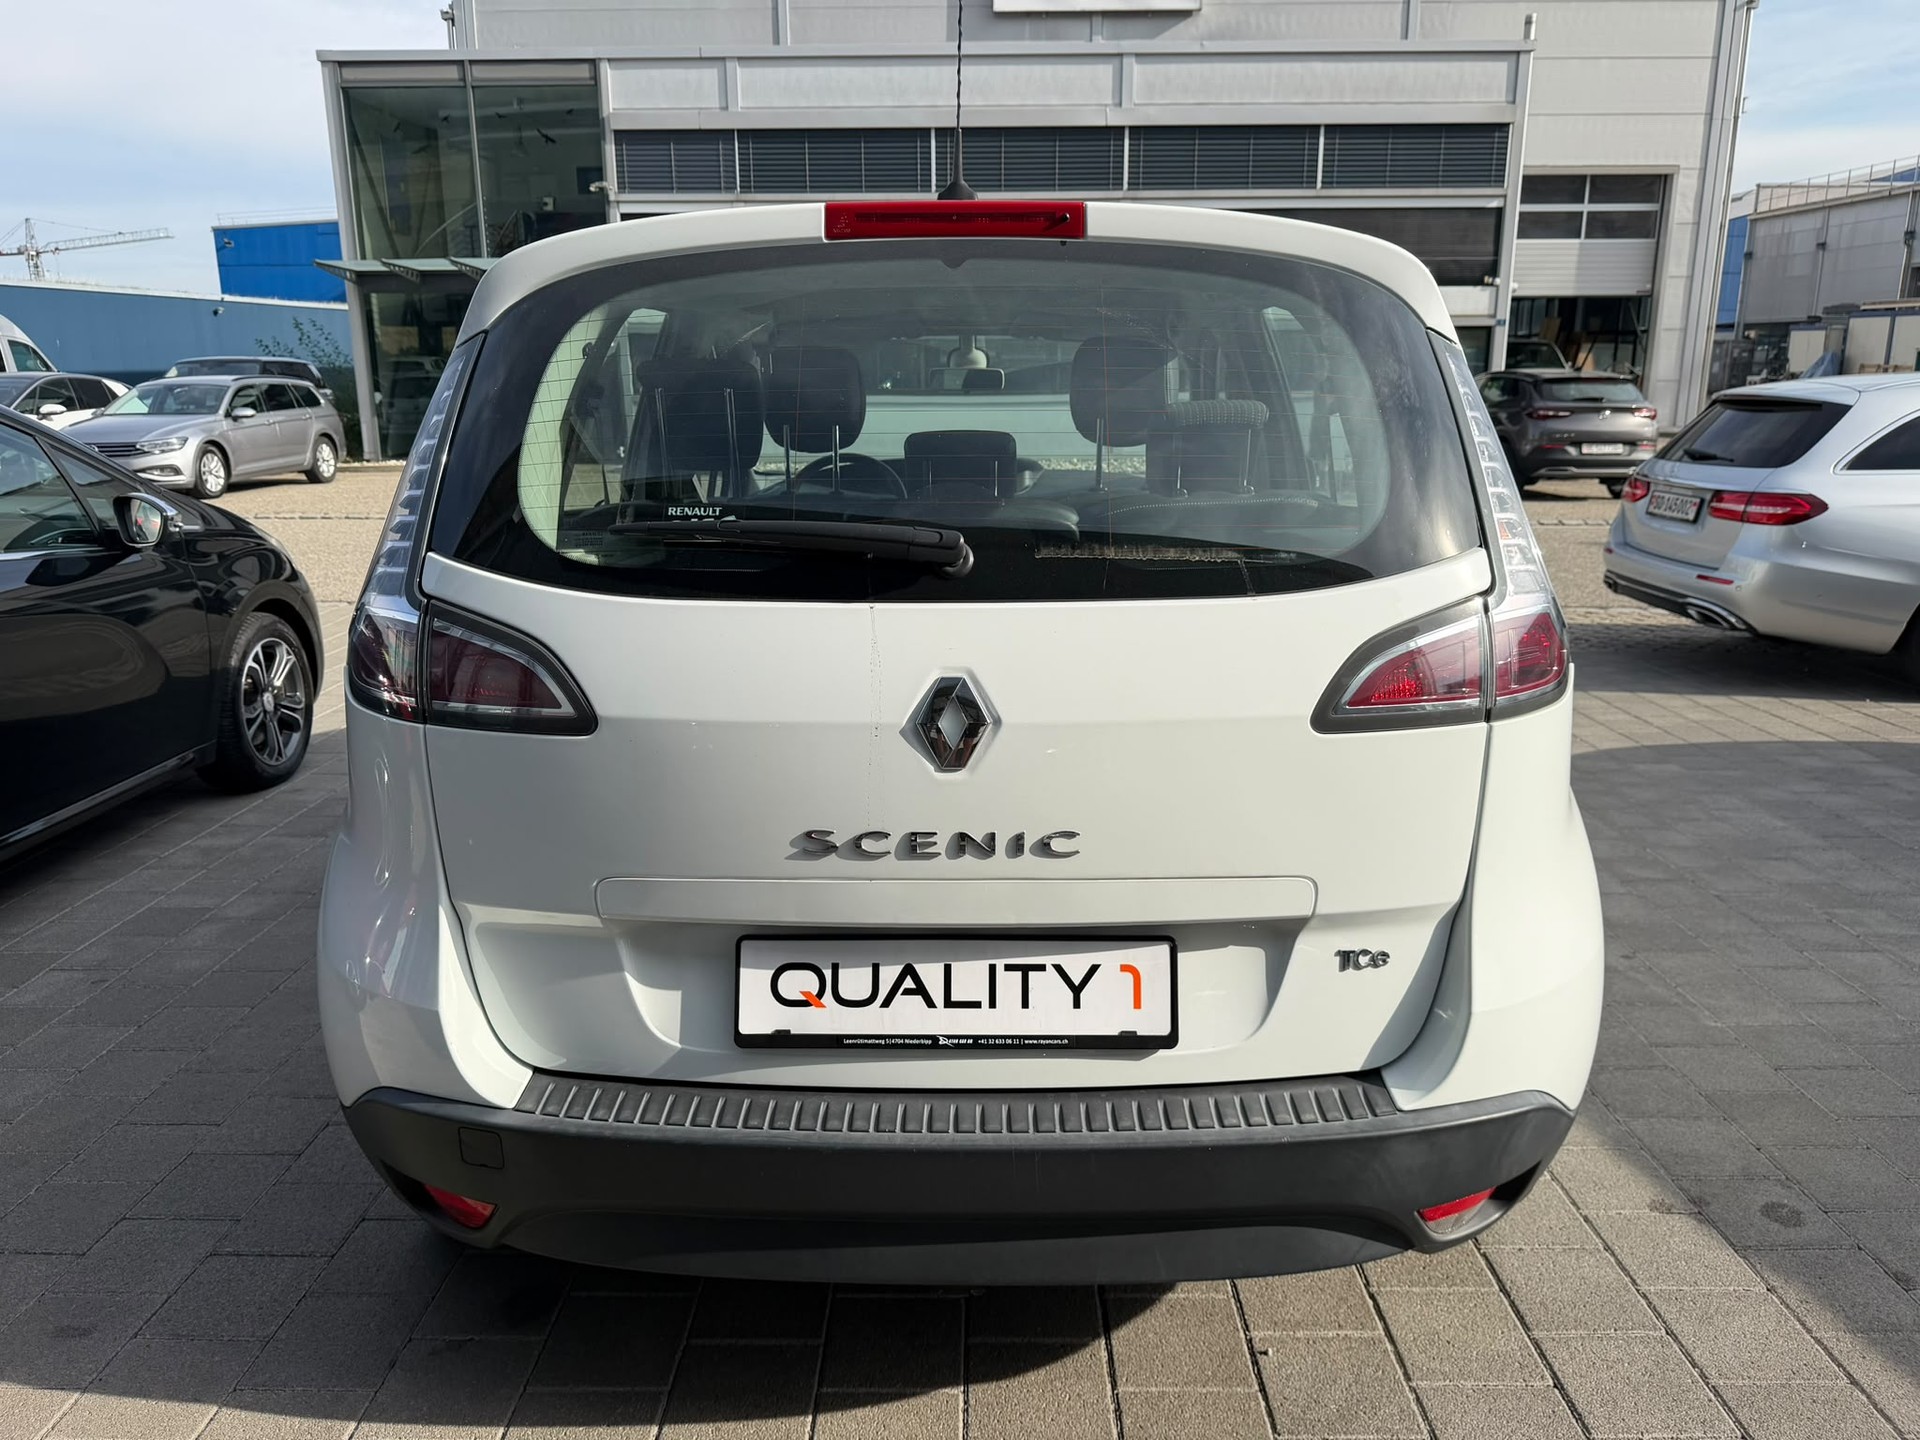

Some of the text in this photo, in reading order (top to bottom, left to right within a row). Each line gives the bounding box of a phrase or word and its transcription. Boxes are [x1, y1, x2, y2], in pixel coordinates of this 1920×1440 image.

[667, 507, 723, 516] RENAULT
[800, 829, 1081, 858] SCENIC
[769, 962, 1102, 1010] QUALITY
